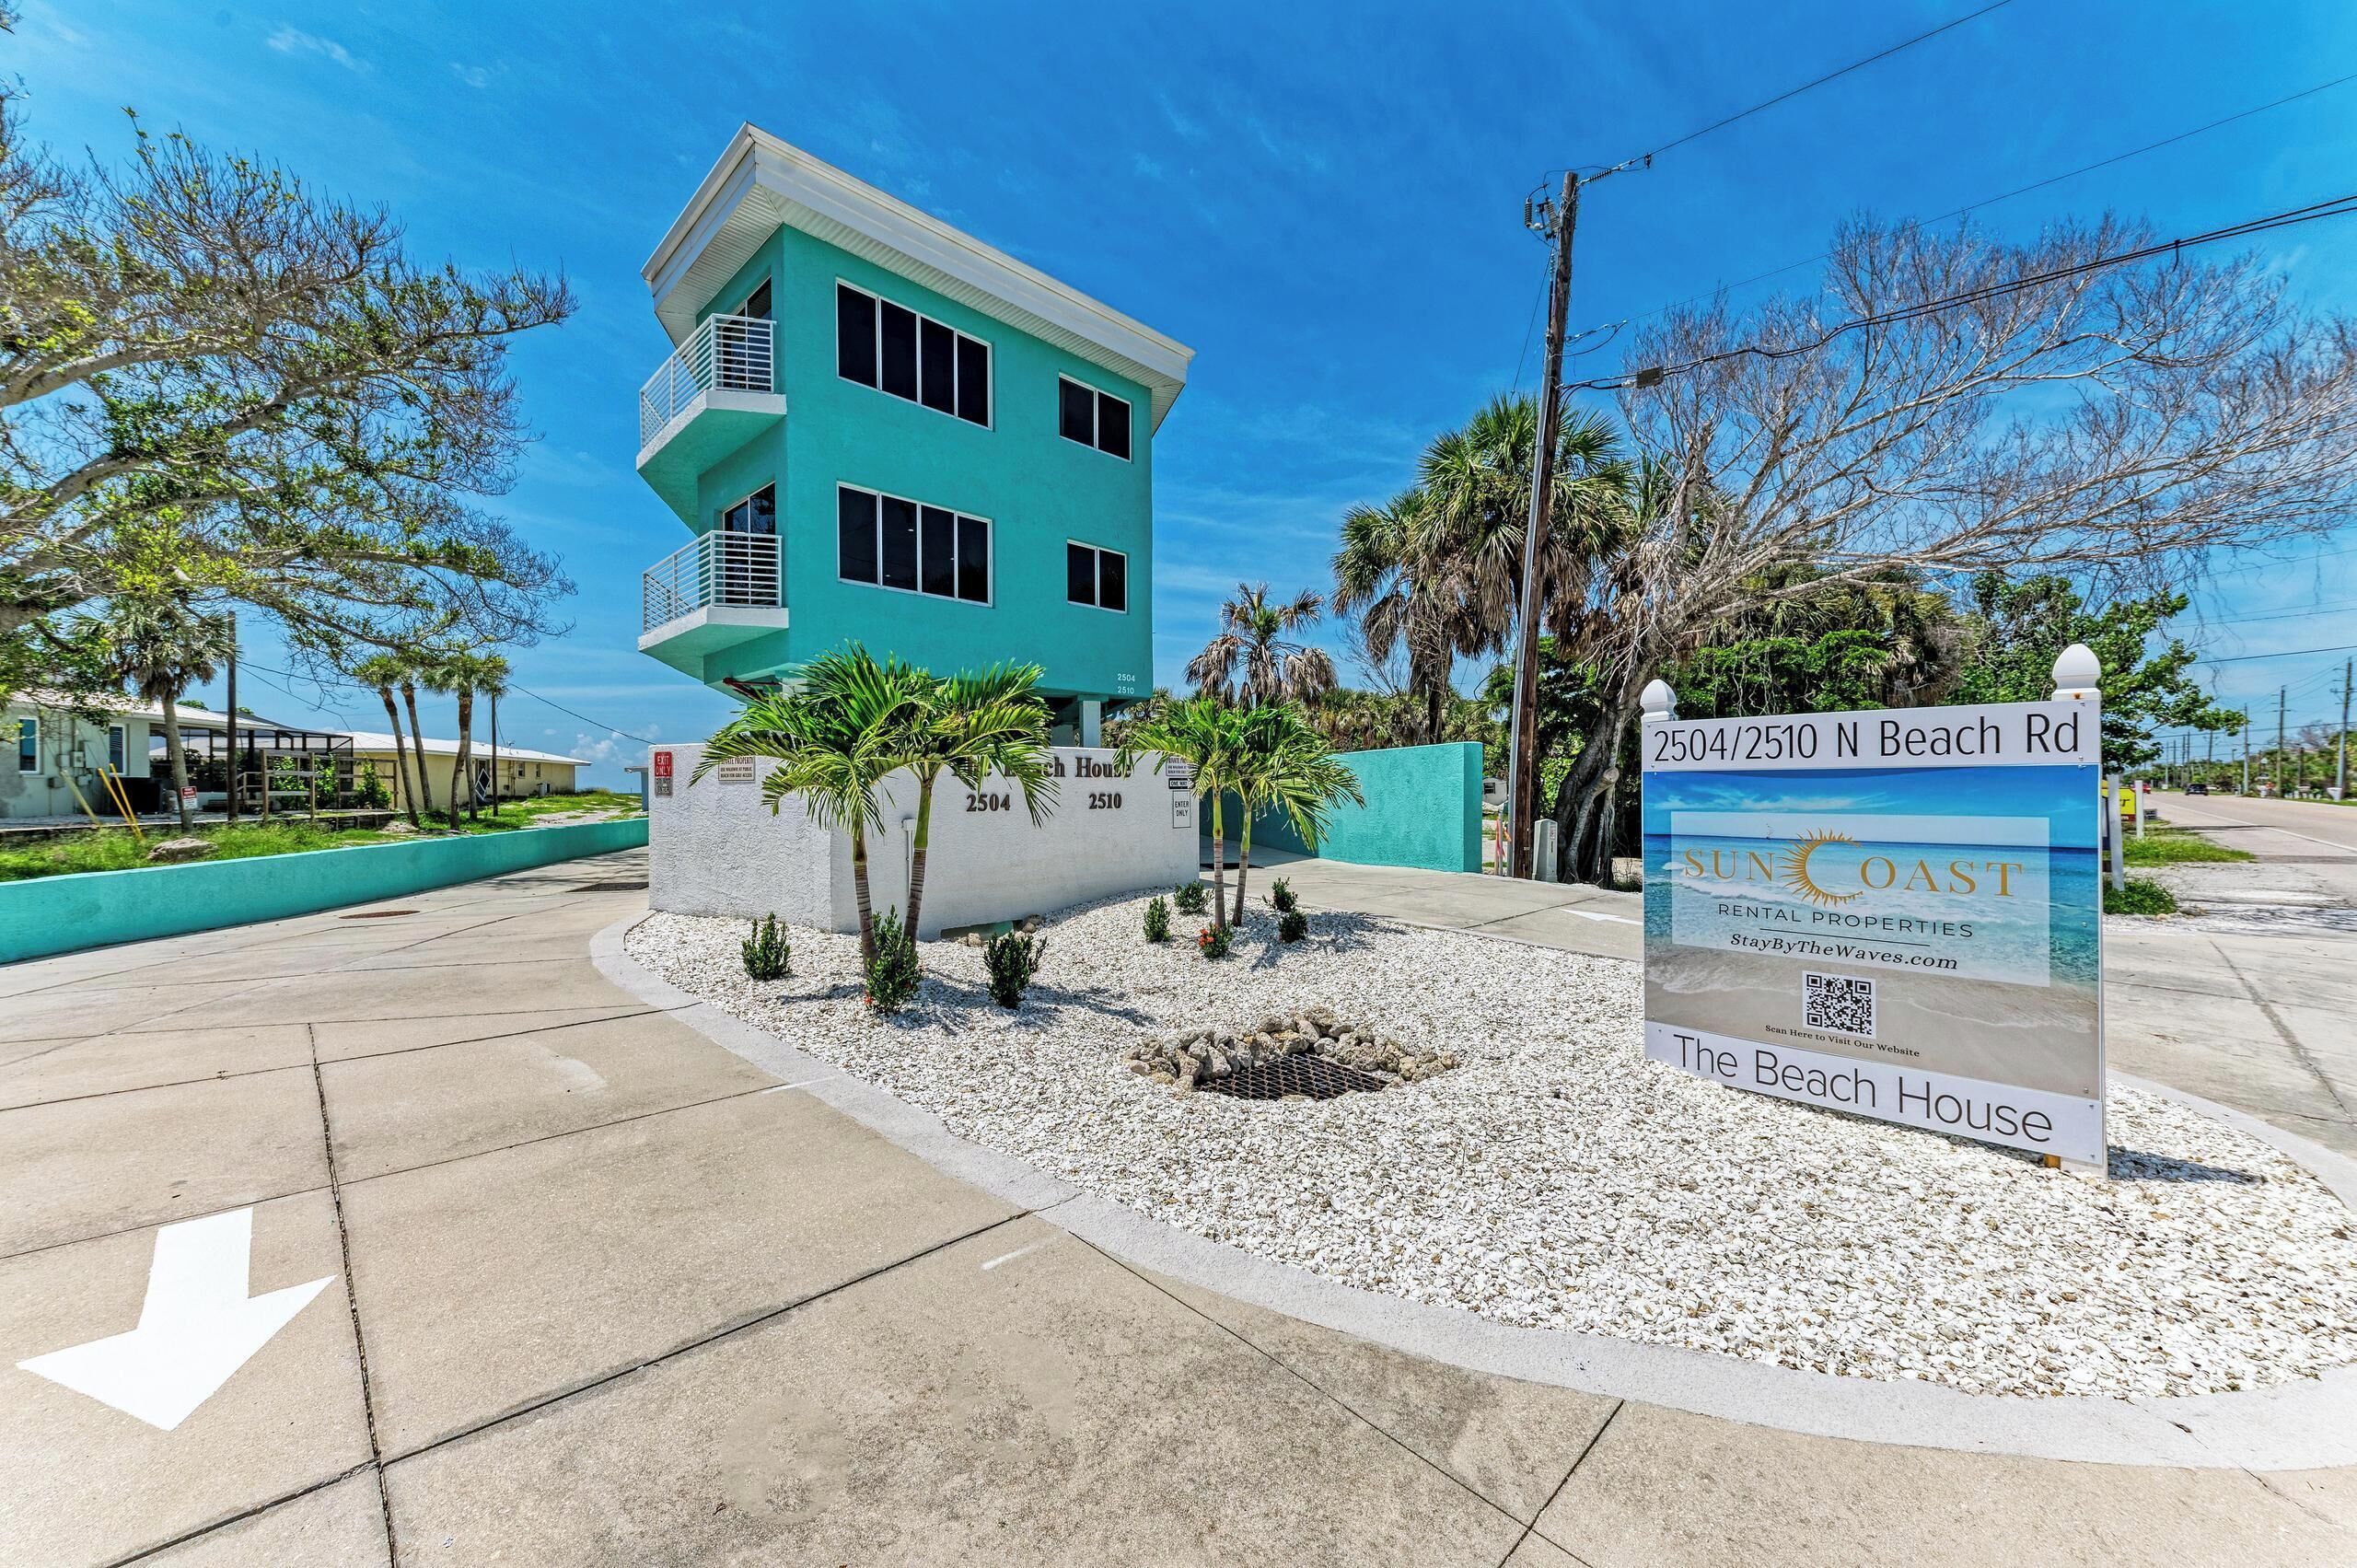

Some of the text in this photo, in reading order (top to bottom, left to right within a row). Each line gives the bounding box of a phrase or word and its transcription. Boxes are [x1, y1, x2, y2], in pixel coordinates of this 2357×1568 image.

[1117, 673, 1135, 682] 2504
[1117, 685, 1135, 694] 2510
[1654, 712, 2079, 762] 2504/2510 N Beach Rd
[656, 755, 670, 765] EXIT
[1074, 757, 1132, 778] House
[655, 765, 671, 775] ONLY
[967, 794, 1011, 812] 2504
[1088, 793, 1122, 809] 2510
[1718, 903, 1973, 937] RENTAL PROPERTIES
[1730, 933, 1958, 970] StayByTheWaves.com
[1765, 1025, 1787, 1035] Scan
[1789, 1028, 1813, 1040] Here
[1829, 1035, 1851, 1046] Visit
[1853, 1040, 1875, 1050] Our
[1876, 1043, 1921, 1058] Website
[1673, 1034, 2052, 1143] The Beach House
